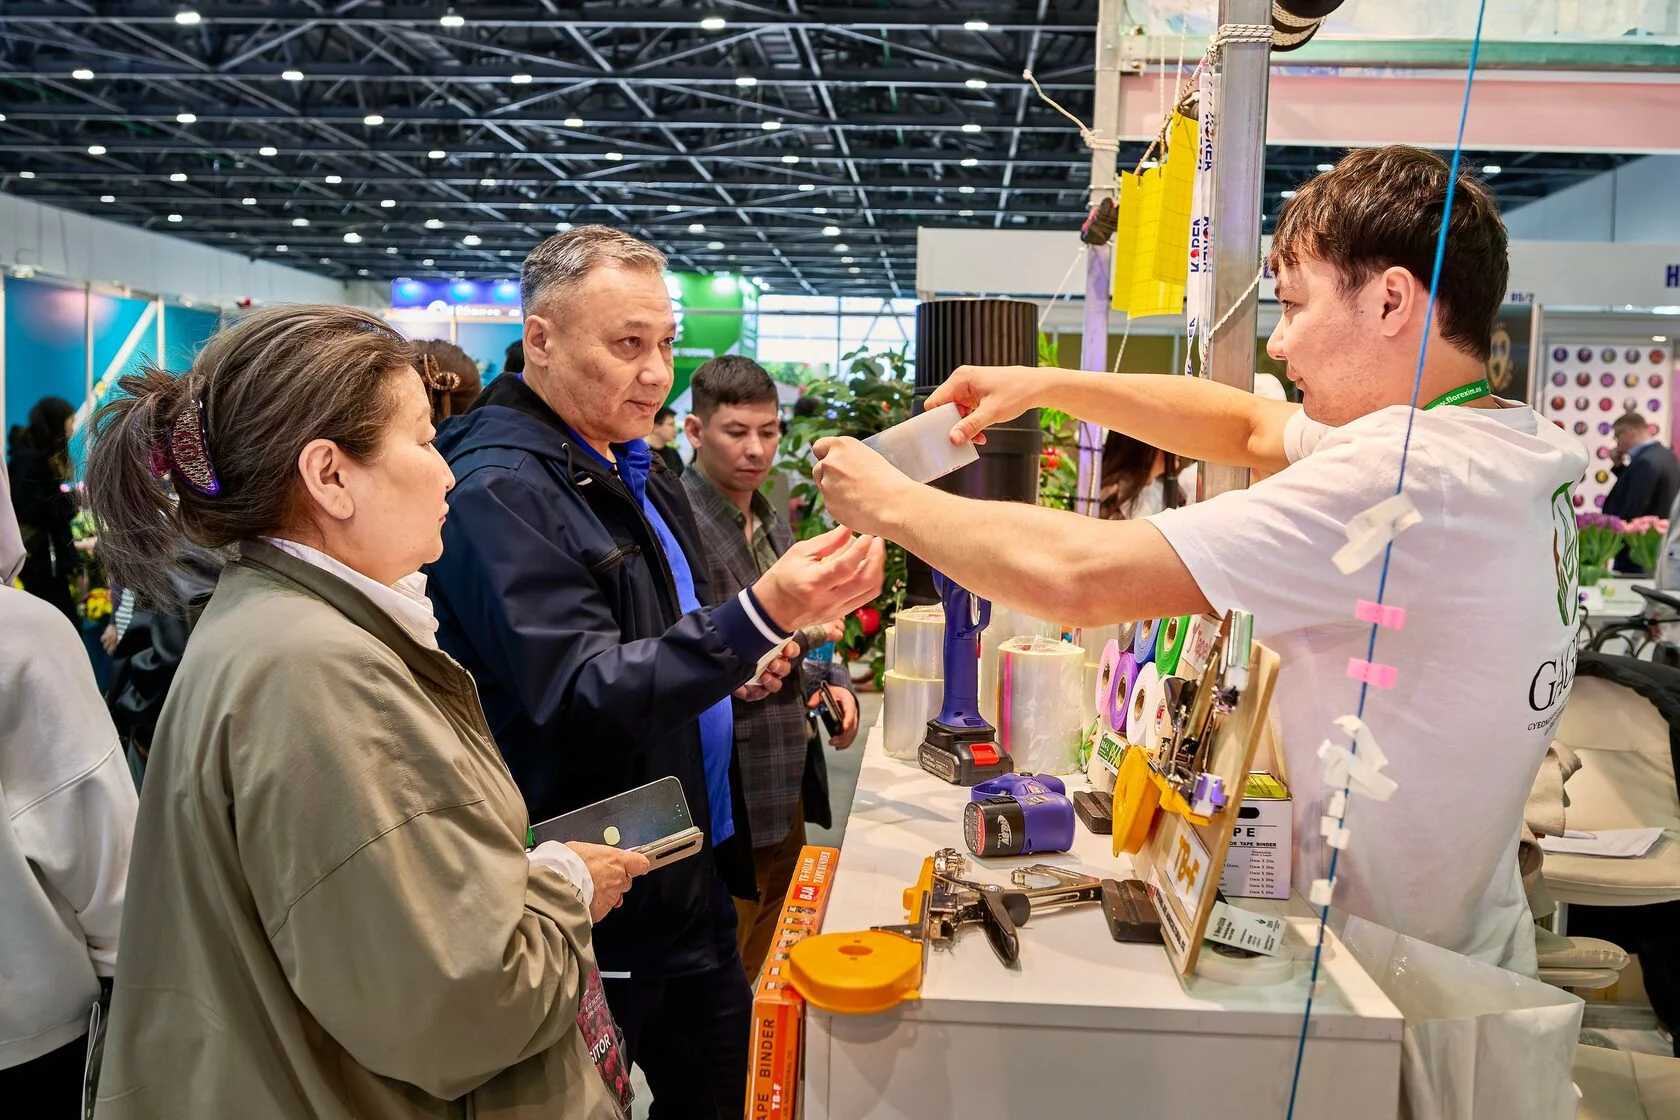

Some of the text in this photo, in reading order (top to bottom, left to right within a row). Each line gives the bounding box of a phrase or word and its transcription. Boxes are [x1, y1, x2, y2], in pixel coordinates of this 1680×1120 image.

[800, 886, 815, 900] BJA
[756, 1018, 775, 1120] APE BINDER
[772, 1083, 782, 1110] TB-F
